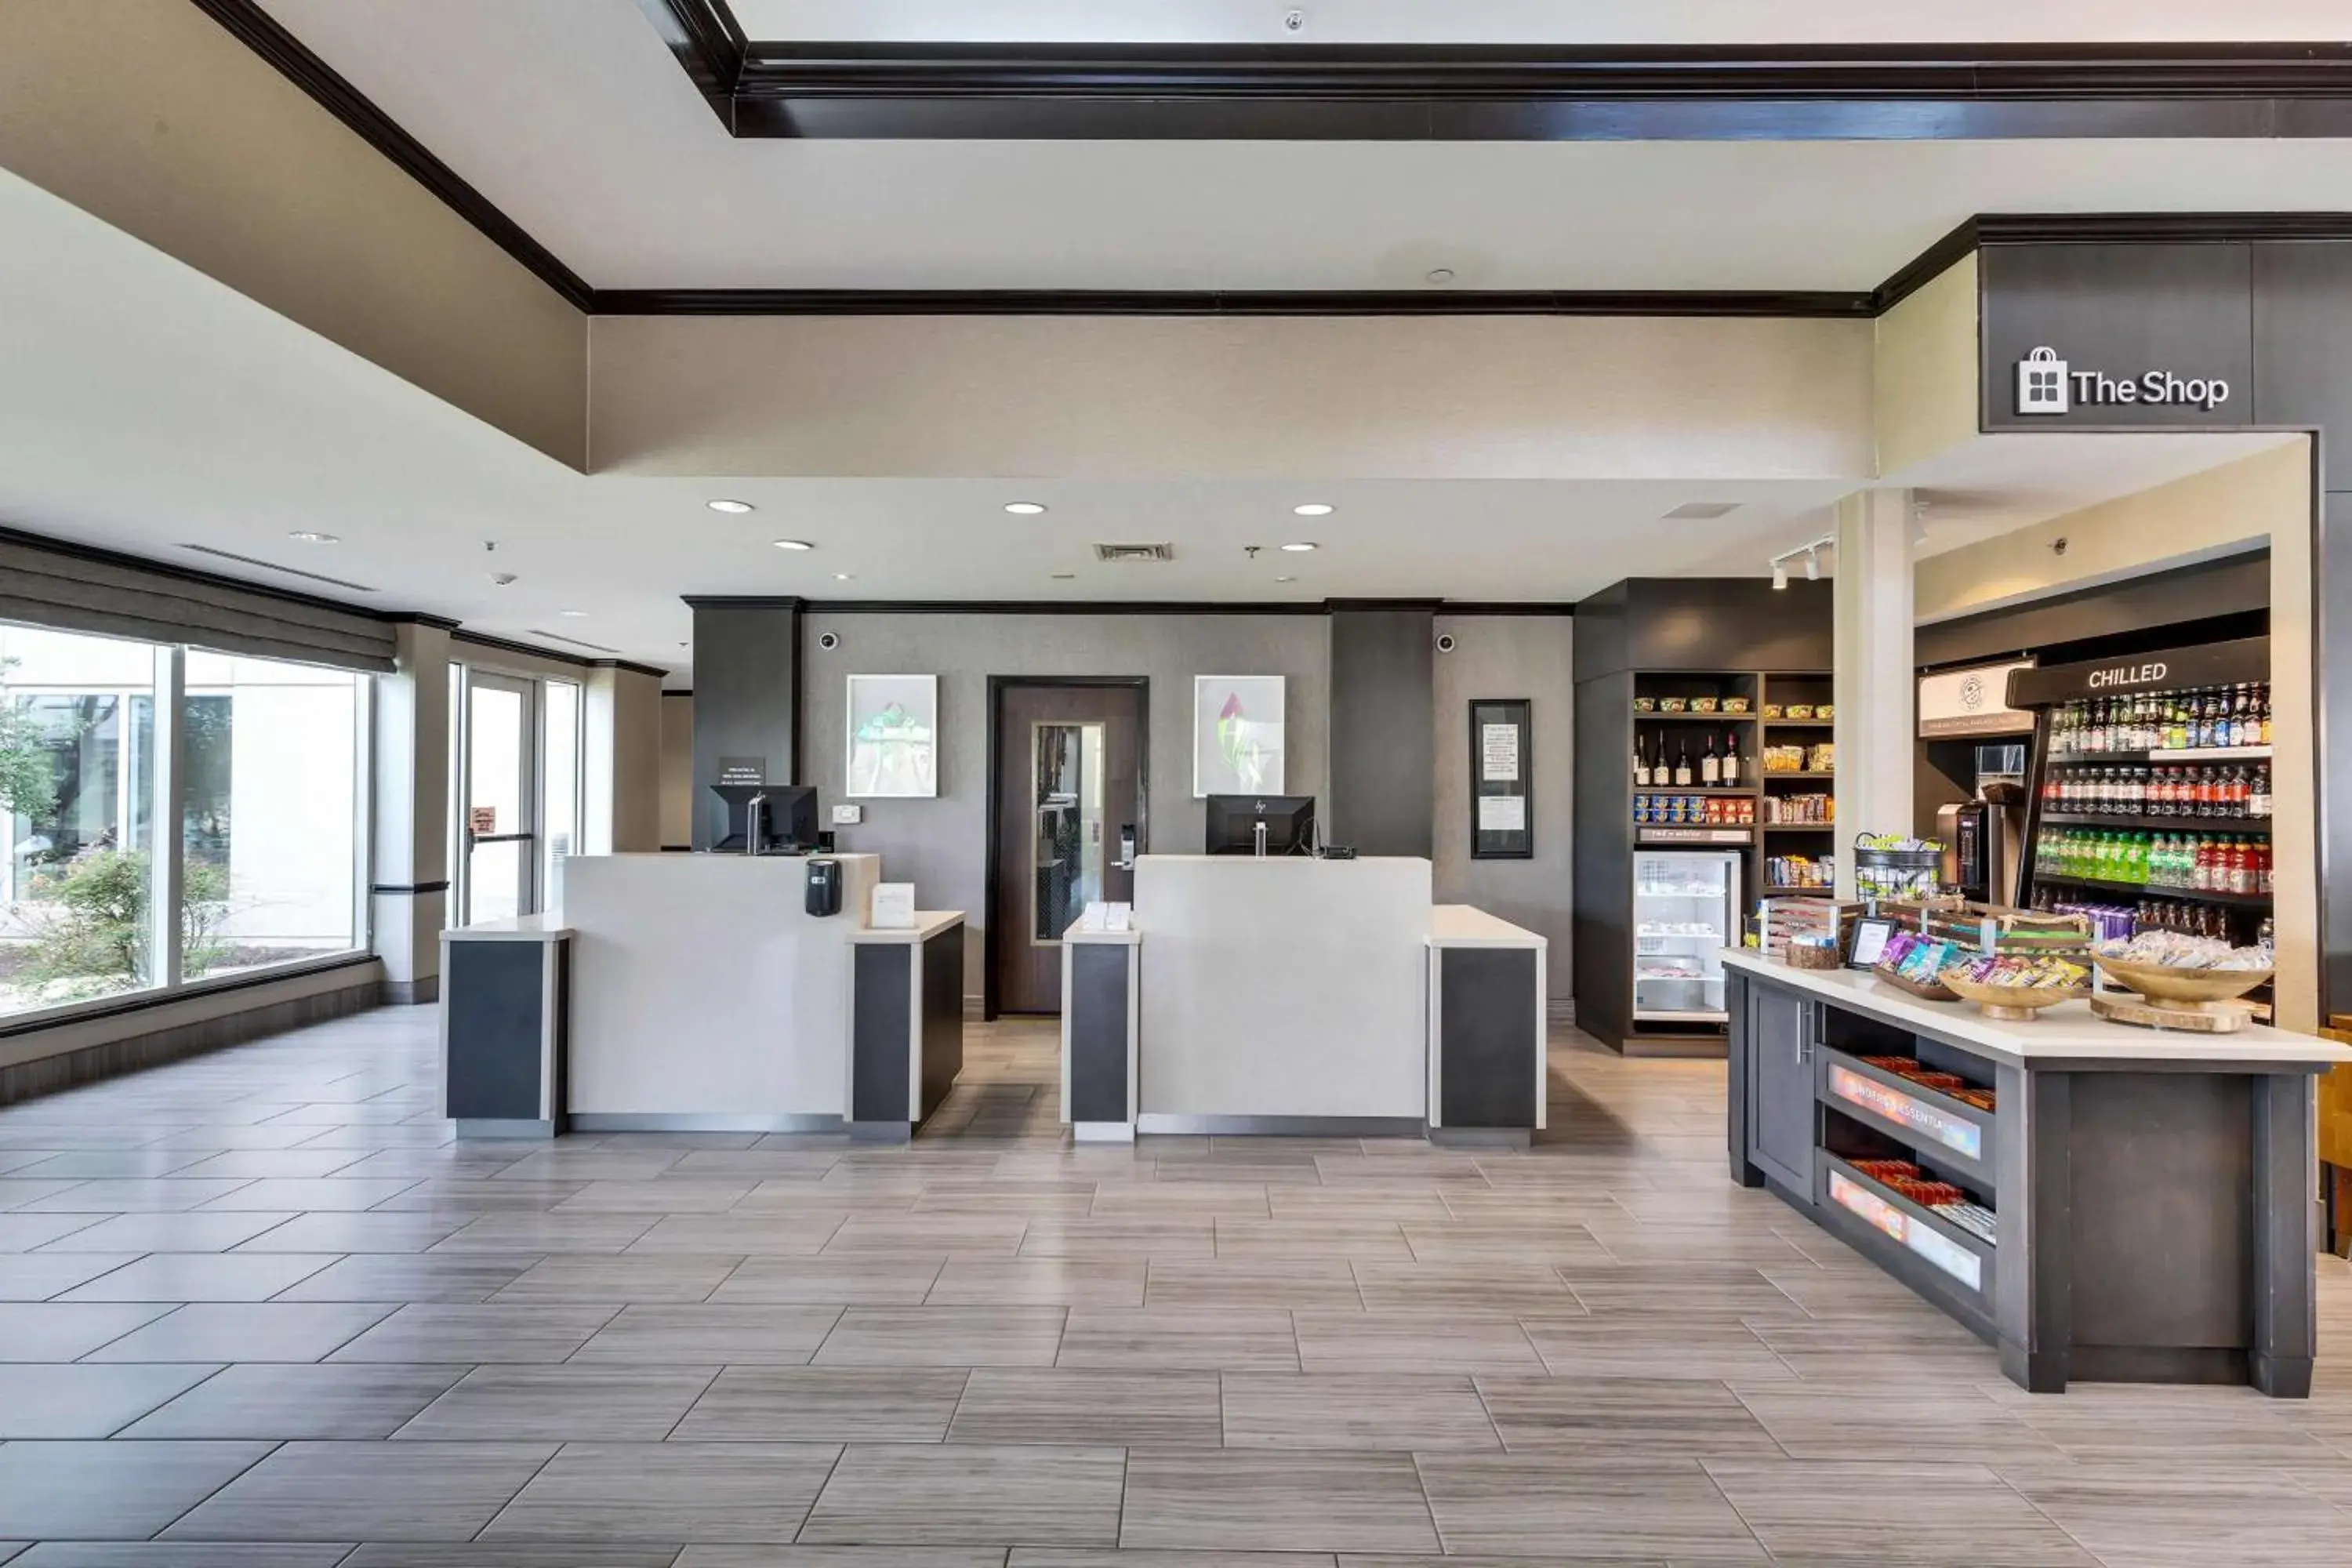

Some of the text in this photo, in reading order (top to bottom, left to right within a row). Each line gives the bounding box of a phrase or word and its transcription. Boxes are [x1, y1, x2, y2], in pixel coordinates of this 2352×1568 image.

[2071, 371, 2229, 408] The Shop
[2089, 662, 2167, 688] CHILLED
